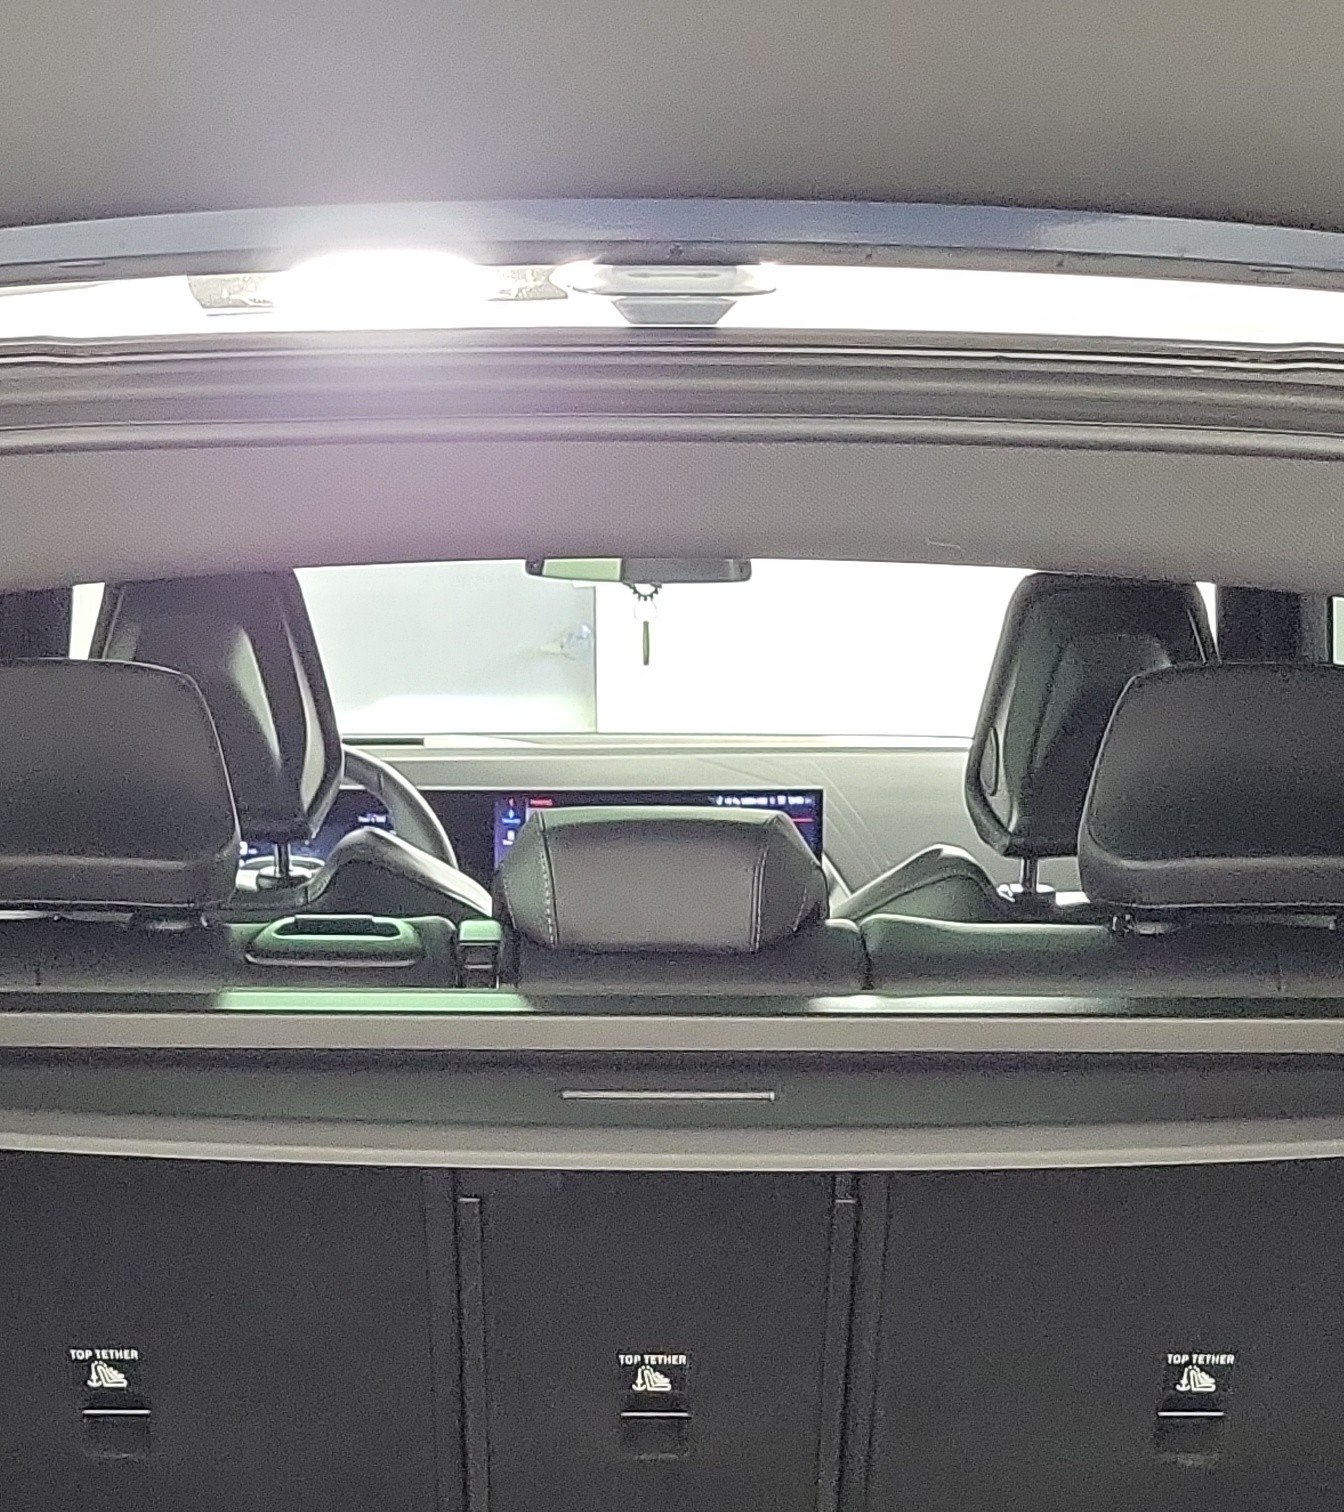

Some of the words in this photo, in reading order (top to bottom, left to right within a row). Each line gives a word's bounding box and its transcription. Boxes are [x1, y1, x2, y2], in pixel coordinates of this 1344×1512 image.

[69, 1348, 93, 1360] TOP
[94, 1348, 139, 1360] TETHER
[618, 1354, 641, 1365] TOP
[643, 1354, 687, 1365] TETHER
[1167, 1353, 1190, 1365] TOP
[1192, 1353, 1235, 1365] TETHER
